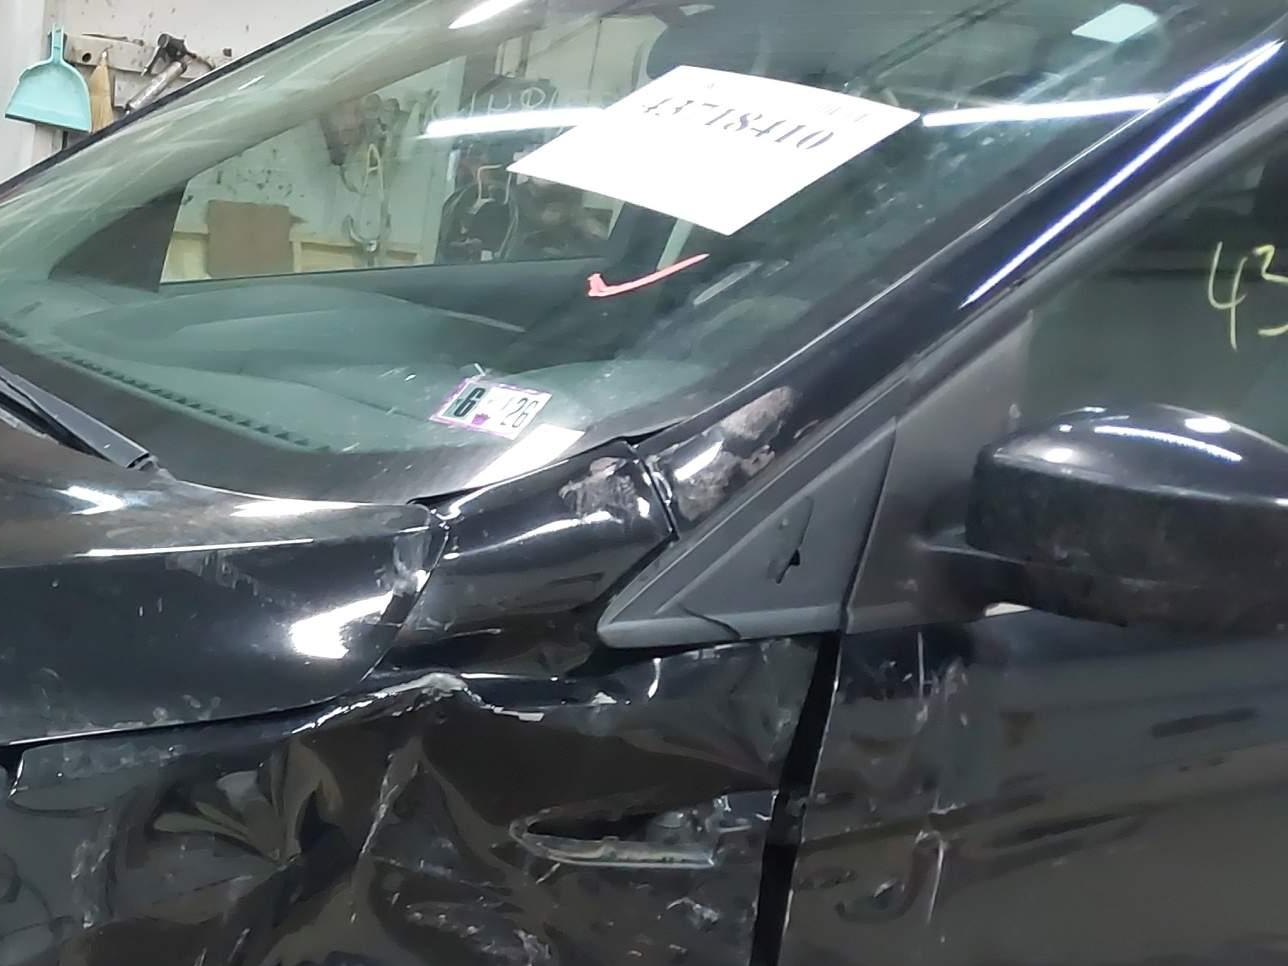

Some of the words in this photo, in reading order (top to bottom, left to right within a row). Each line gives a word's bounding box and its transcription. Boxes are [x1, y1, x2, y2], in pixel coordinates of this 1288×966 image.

[641, 97, 835, 150] 43718410
[453, 387, 486, 417] 6
[500, 397, 539, 428] 26
